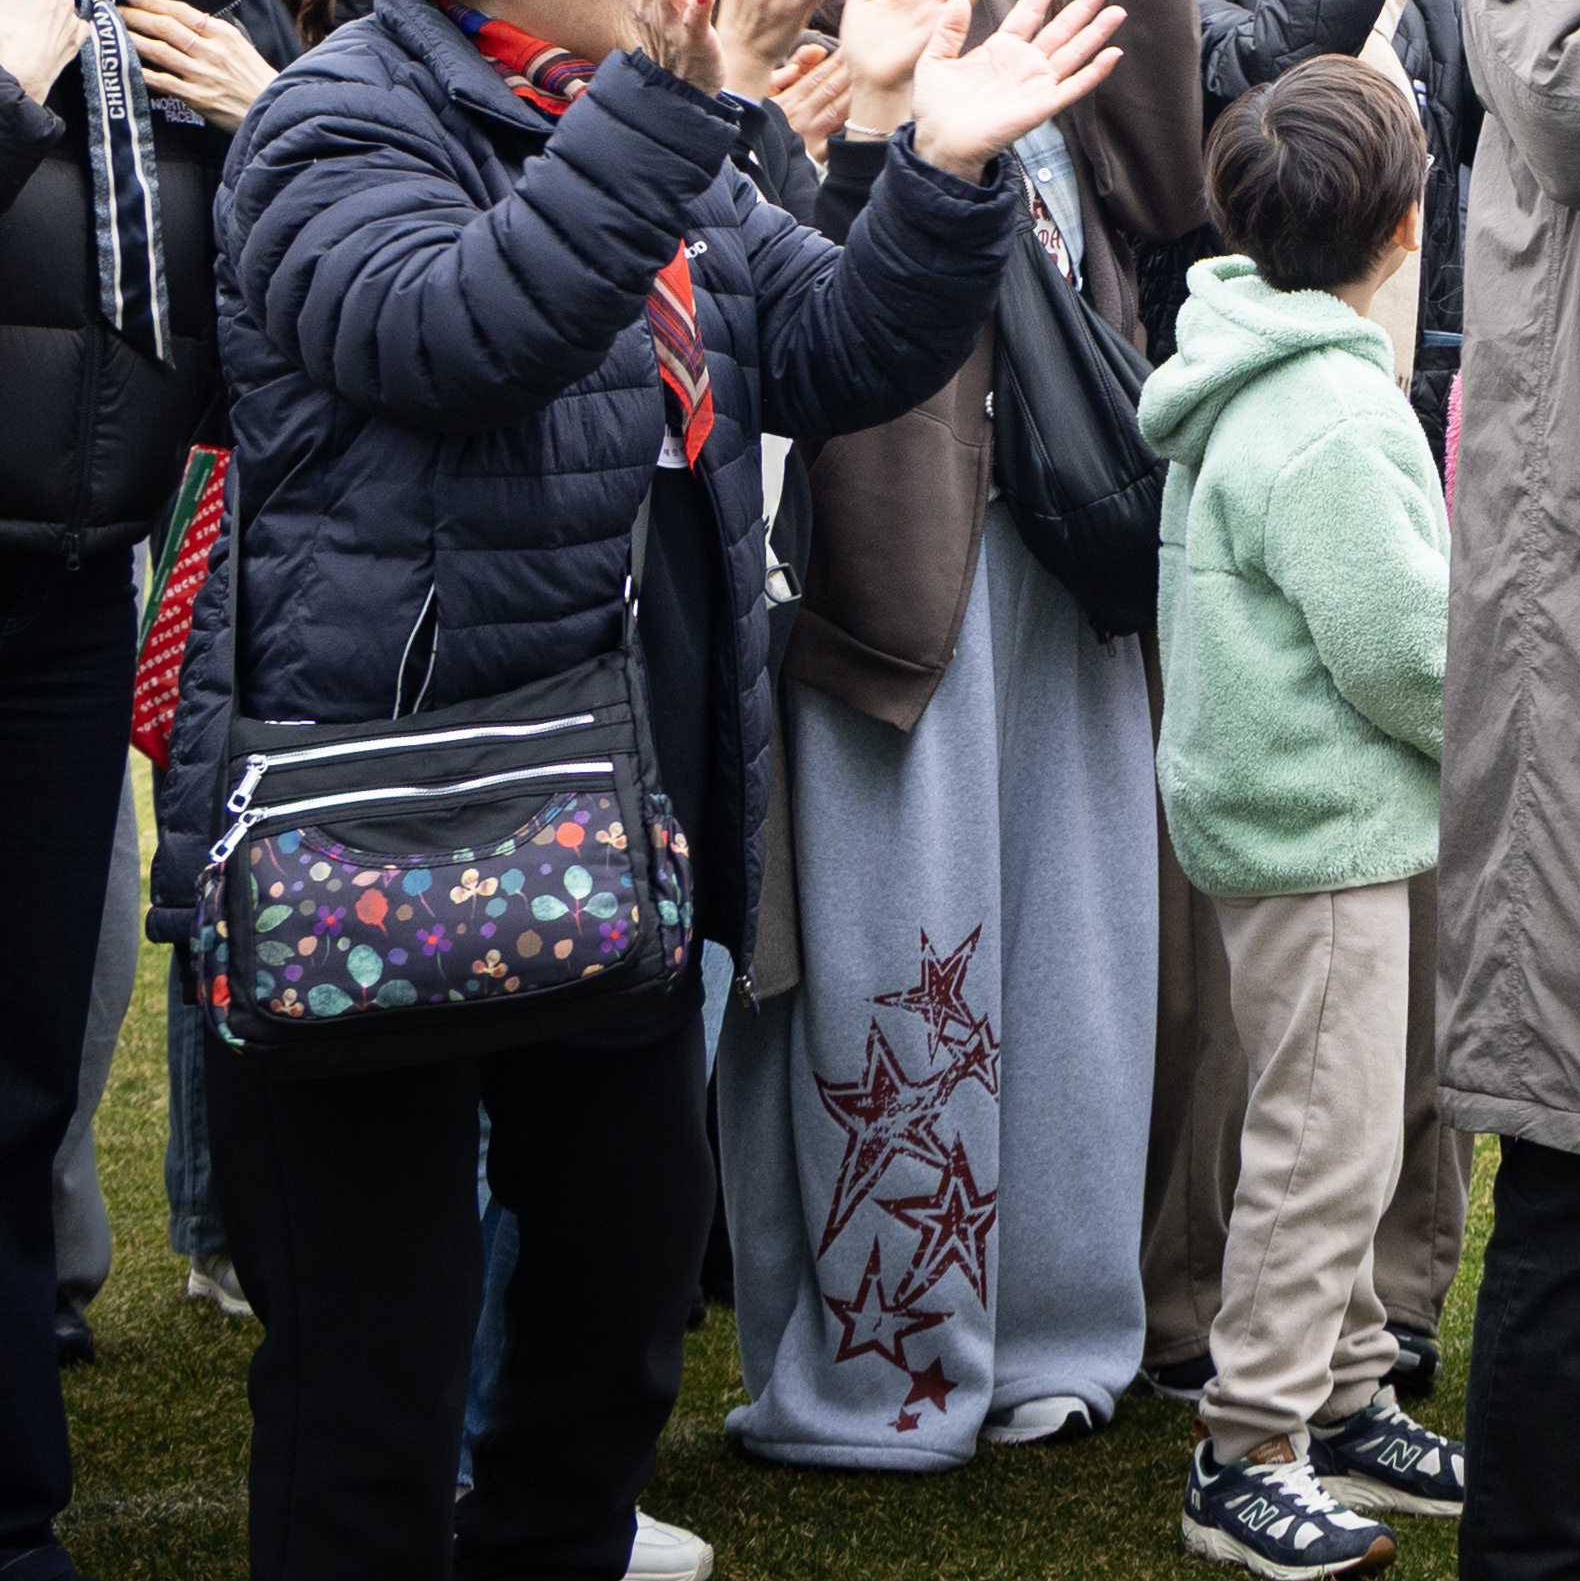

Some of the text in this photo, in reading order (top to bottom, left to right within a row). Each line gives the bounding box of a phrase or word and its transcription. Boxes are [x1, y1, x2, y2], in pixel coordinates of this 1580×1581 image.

[94, 11, 125, 120] CHRISTIAN
[1378, 1438, 1422, 1472] N
[1238, 1497, 1280, 1531] N
